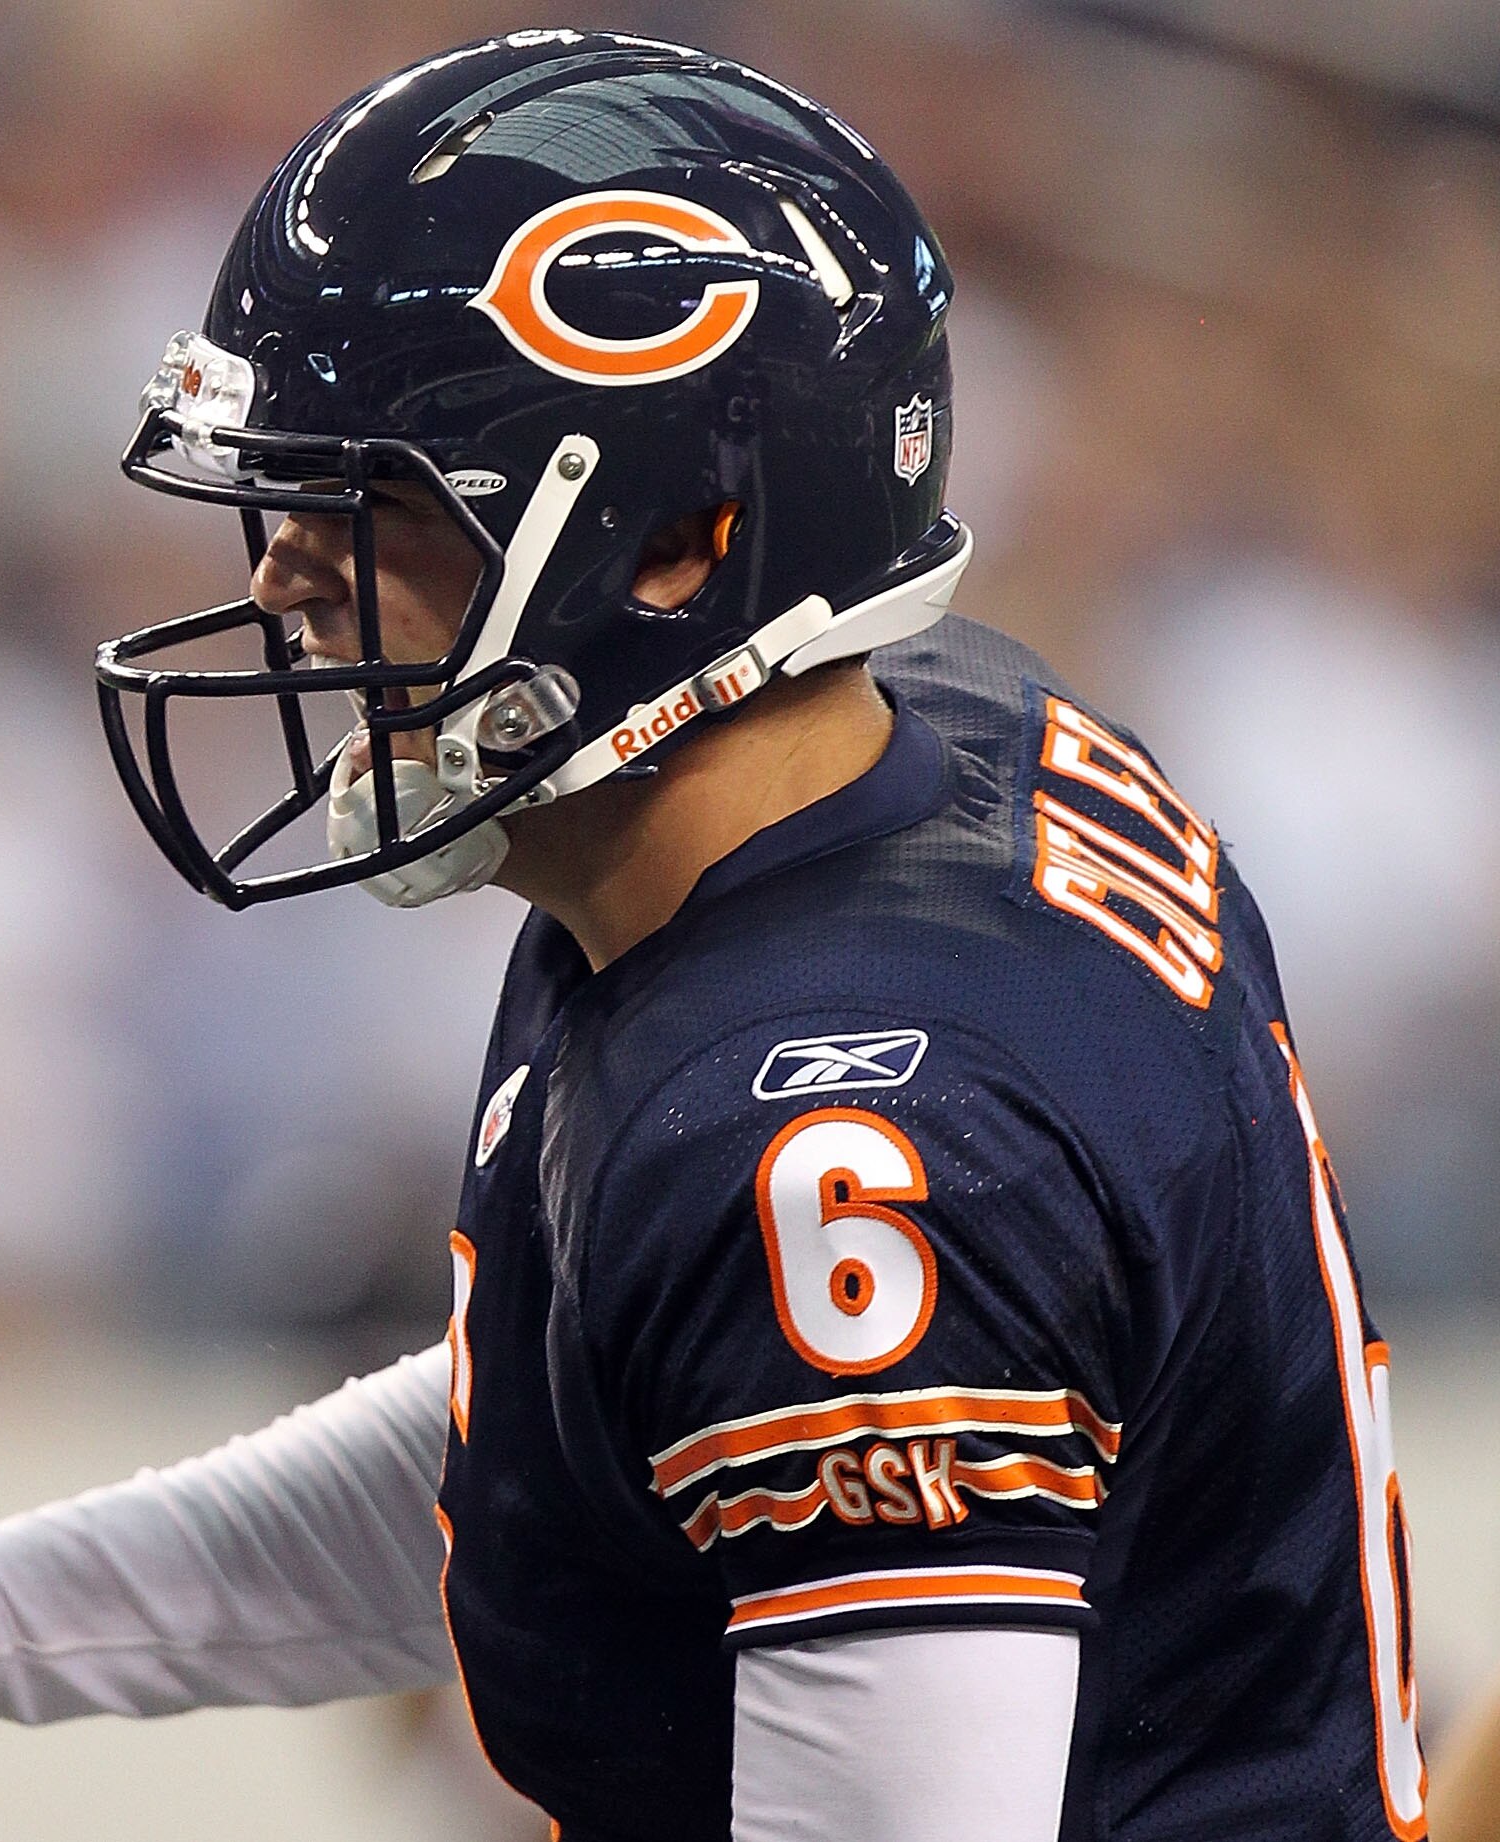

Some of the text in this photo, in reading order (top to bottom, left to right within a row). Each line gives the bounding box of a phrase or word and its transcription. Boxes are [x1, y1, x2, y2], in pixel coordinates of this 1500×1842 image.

[611, 673, 743, 762] Riddll
[755, 1106, 938, 1376] 6
[816, 1438, 970, 1531] GSH
